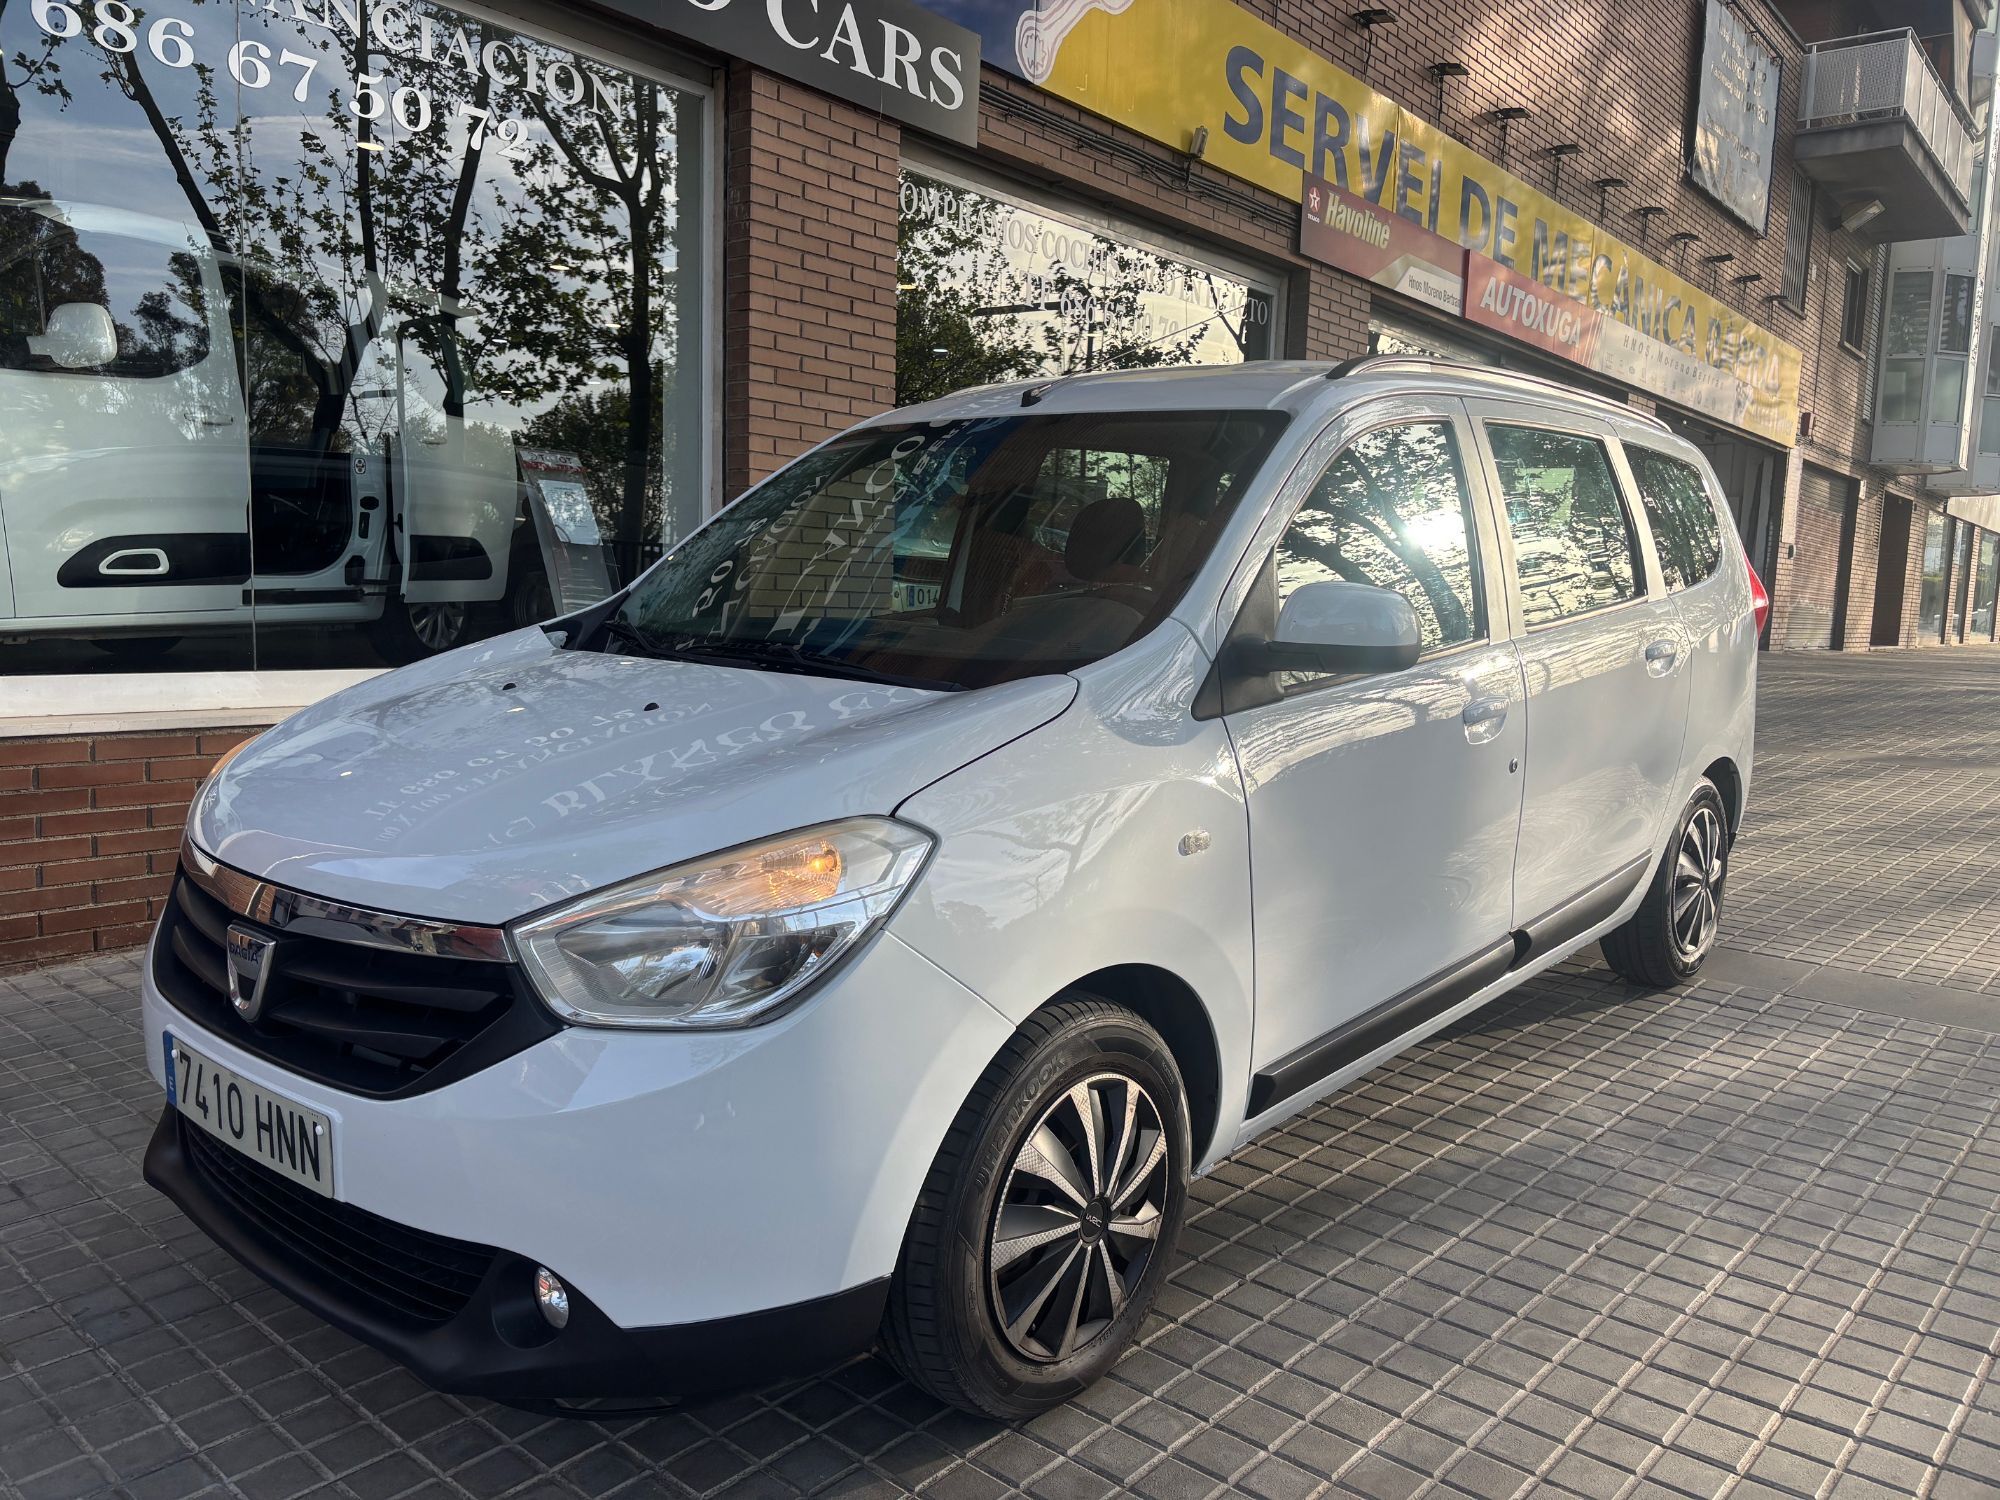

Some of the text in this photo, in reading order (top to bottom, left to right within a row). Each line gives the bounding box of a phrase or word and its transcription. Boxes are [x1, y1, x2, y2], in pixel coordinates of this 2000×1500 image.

[31, 0, 531, 161] 686 67 50 72
[766, 0, 964, 110] CARS
[1223, 45, 1442, 233] SERVEI
[1459, 175, 1519, 271] DE
[1325, 190, 1391, 249] Havoline
[1480, 277, 1581, 347] AUTOXUGA
[178, 1050, 321, 1182] 7410 HNN
